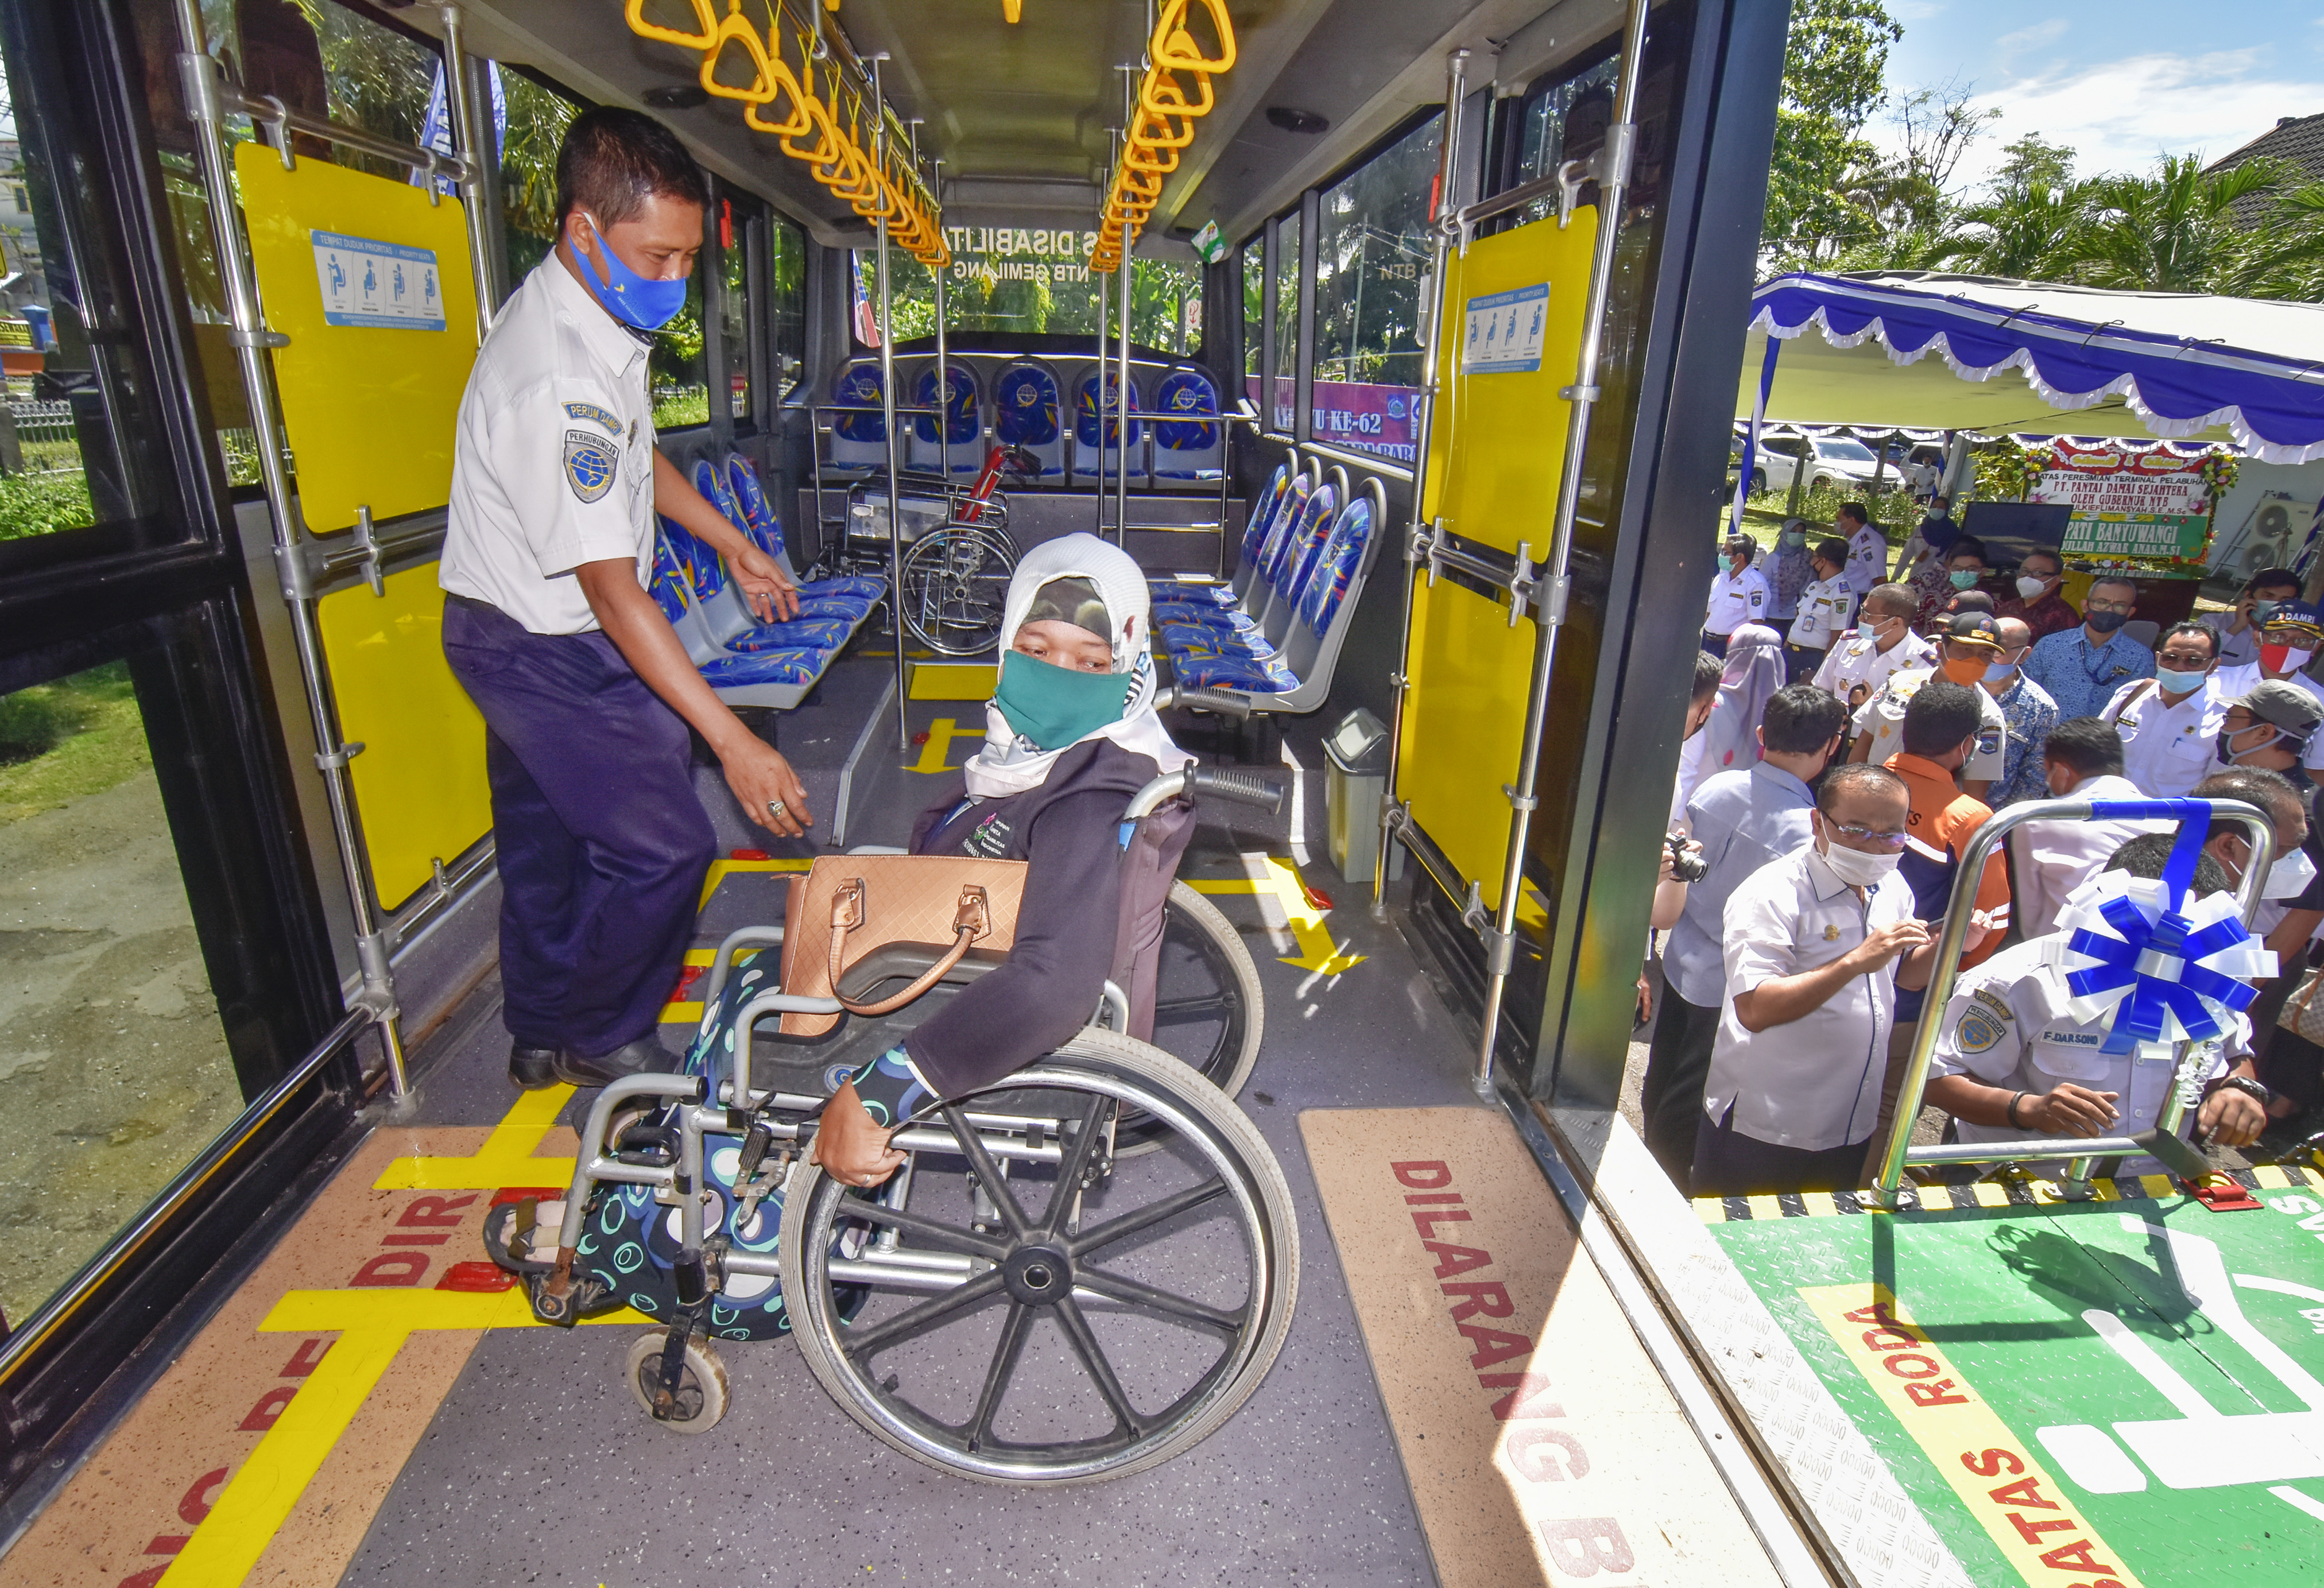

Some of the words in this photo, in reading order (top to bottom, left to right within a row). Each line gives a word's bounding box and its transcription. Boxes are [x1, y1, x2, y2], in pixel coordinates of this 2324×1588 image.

[319, 235, 343, 247] TEMPAT
[344, 239, 365, 250] DUDUK
[365, 242, 392, 255] PRIORITAS
[400, 249, 418, 258] PRIORITY
[1471, 299, 1483, 308] TEMPAT
[1484, 297, 1494, 307] DUDUK
[1495, 294, 1514, 304] PRIORITAS
[1519, 290, 1532, 299] PRIORITY
[1533, 288, 1544, 297] SEATS
[570, 405, 599, 420] PERUM
[599, 412, 619, 433] DAMRI
[1312, 408, 1325, 431] U
[1330, 410, 1382, 434] KE-62
[570, 432, 617, 457] PERHUBUNGAN
[2062, 474, 2111, 482] PERESMIAN
[2114, 475, 2156, 483] TERMINAL
[2160, 477, 2210, 486] PELABUHAN
[2106, 483, 2136, 494] DAMAI
[2137, 484, 2188, 497] SEJAHTERA
[2070, 493, 2096, 504] OLEH
[2099, 494, 2145, 506] GUBERNUR
[2148, 496, 2168, 507] NTB
[2095, 522, 2178, 544] BANYUWANGI
[2285, 612, 2315, 625] DAMRI
[1976, 991, 1996, 1006] PERUM
[1994, 1002, 2009, 1020] DAMRI
[1970, 1008, 2004, 1034] PERHUBUNGAN
[1390, 1160, 1590, 1483] DILARANG
[1842, 1301, 1970, 1408] RODA
[1960, 1448, 2128, 1588] ATAS
